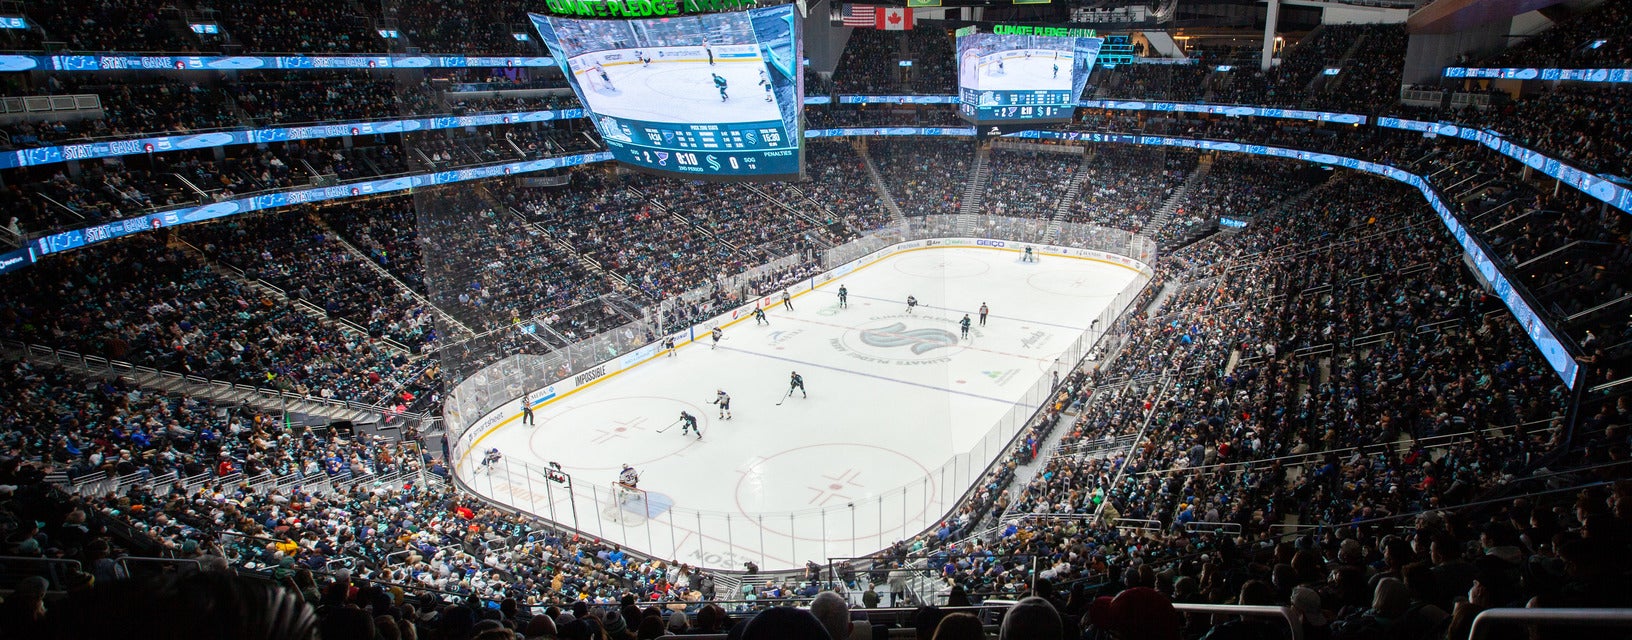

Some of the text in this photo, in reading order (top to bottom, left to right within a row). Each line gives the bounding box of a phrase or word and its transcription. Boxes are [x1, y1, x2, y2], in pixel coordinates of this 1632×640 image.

[547, 0, 607, 16] CLIMATE
[607, 0, 679, 16] PLEDGE
[993, 24, 1097, 38] CLIMATE PLEDGE ARENA
[101, 56, 128, 69] STAT
[141, 56, 173, 69] GAME
[1001, 107, 1006, 117] 2
[63, 144, 94, 160] STAT
[109, 140, 141, 154] GAME
[643, 151, 653, 163] 2
[675, 152, 698, 166] 8:10
[729, 157, 739, 170] 0
[87, 225, 111, 243] STAT
[123, 215, 149, 233] GAME
[976, 239, 1005, 247] GEICO
[574, 365, 606, 387] IMPOSSIBLE
[473, 411, 504, 438] smartsheet
[625, 474, 635, 482] 35
